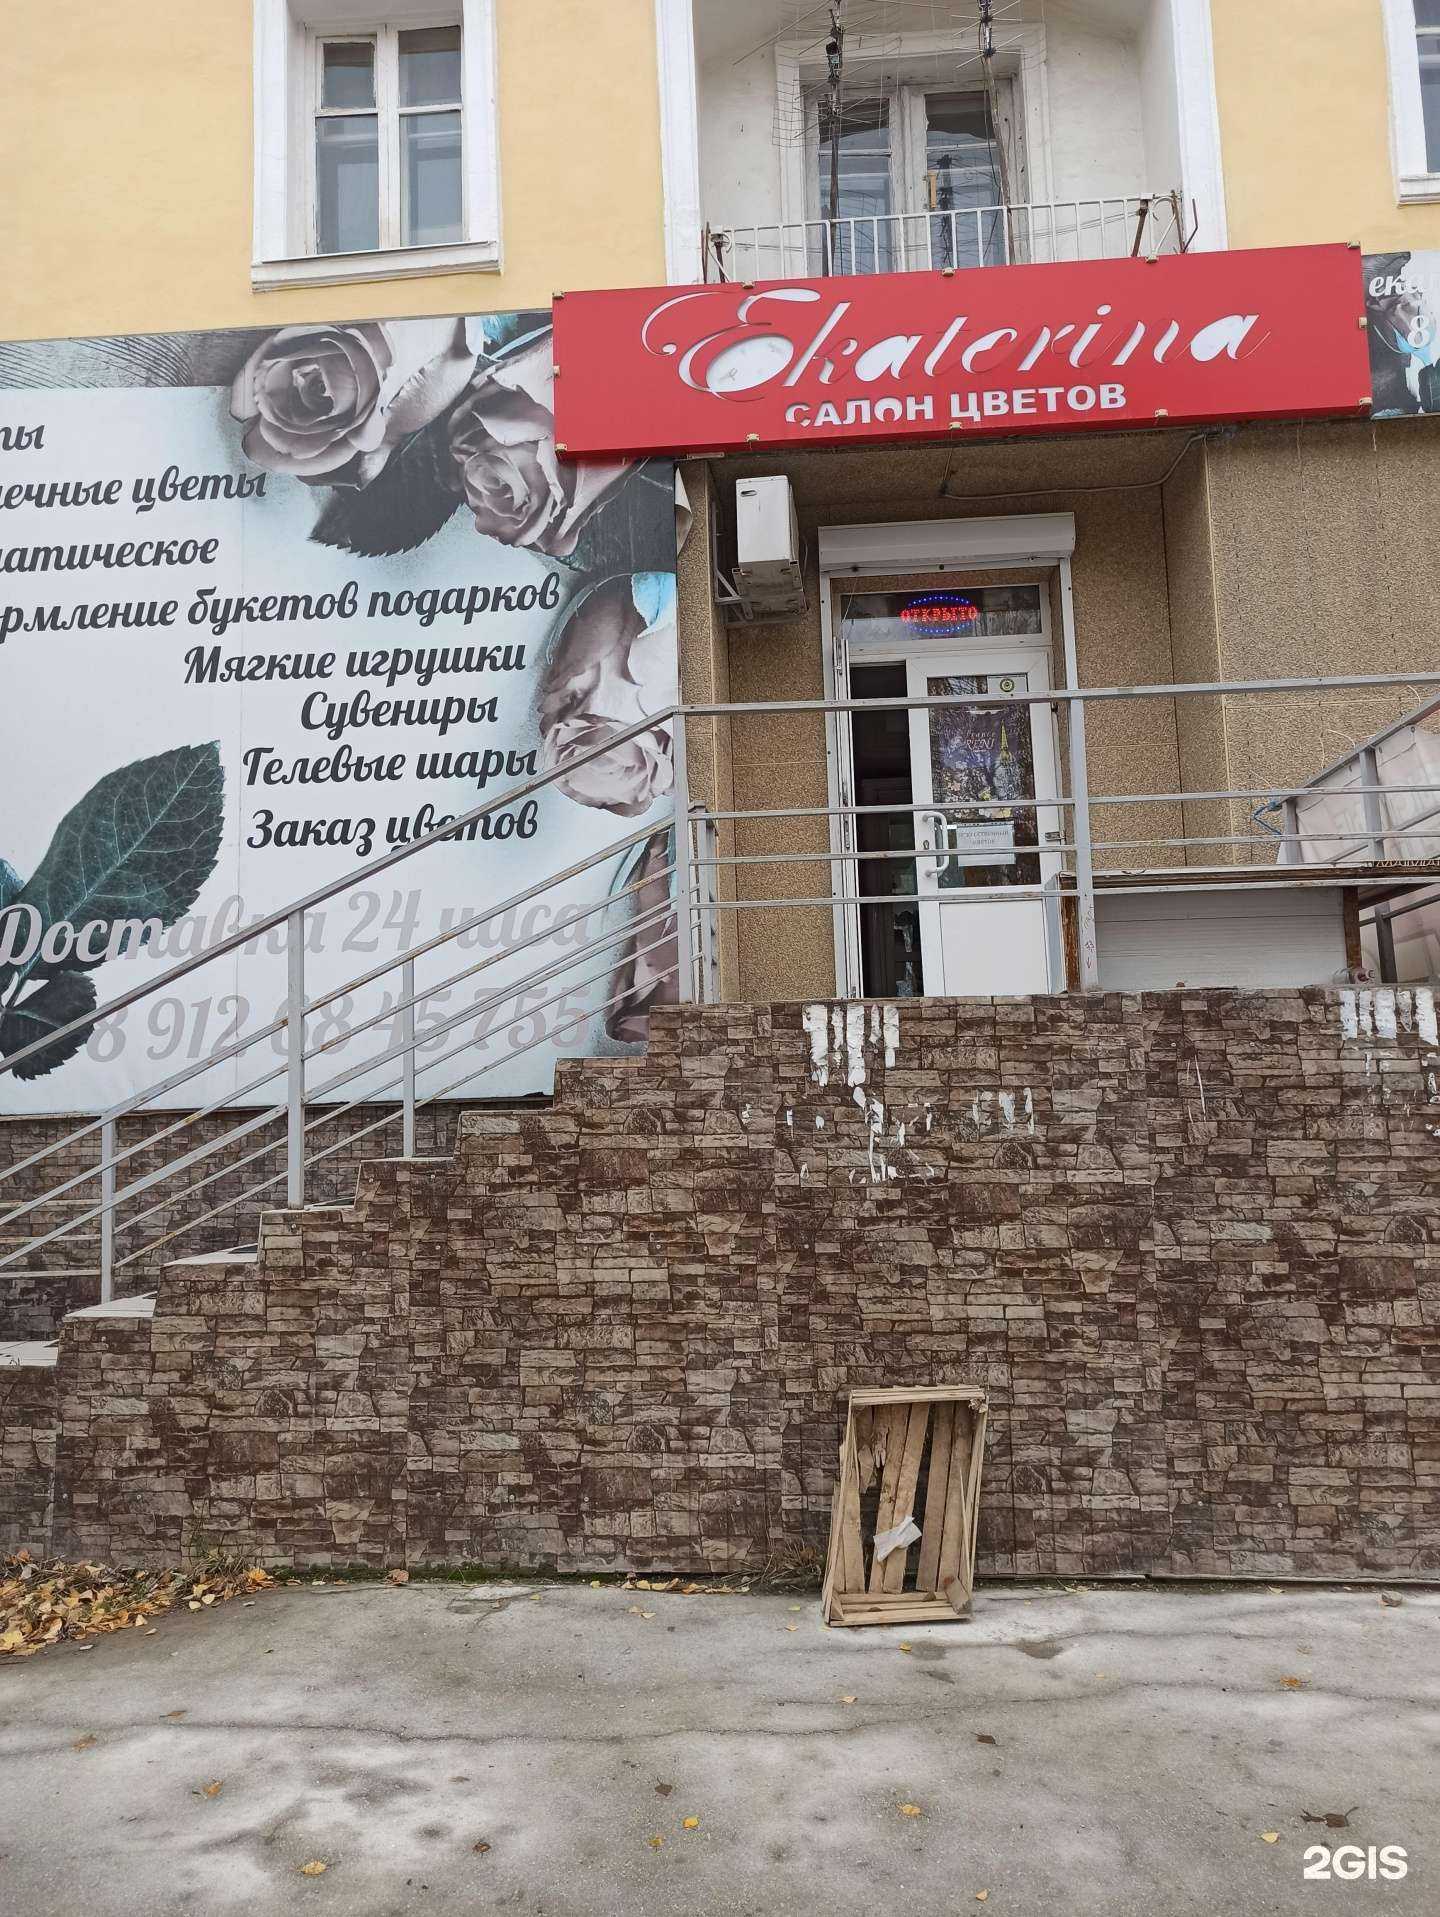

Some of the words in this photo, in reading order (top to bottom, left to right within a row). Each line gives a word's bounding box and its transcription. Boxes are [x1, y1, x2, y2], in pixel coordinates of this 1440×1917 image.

[641, 287, 1272, 402] Ekaterina
[784, 395, 934, 427] САЛОН
[949, 382, 1127, 424] ЦВЕТОВ
[0, 479, 123, 510] ечные
[132, 465, 267, 515] цветы
[0, 538, 219, 573] атическое
[0, 599, 179, 644] рмление
[188, 581, 358, 637] букетов
[367, 572, 560, 627] подарков
[184, 646, 335, 685] Мягкие
[346, 642, 526, 688] игрушки
[300, 691, 499, 741] Сувениры
[242, 747, 405, 786] Гелевые
[416, 745, 538, 789] шары
[247, 809, 375, 857] Заказ
[341, 889, 422, 953] 24
[439, 900, 592, 950] часа
[86, 997, 129, 1063] 8
[146, 994, 251, 1061] 912
[472, 986, 592, 1052] 755
